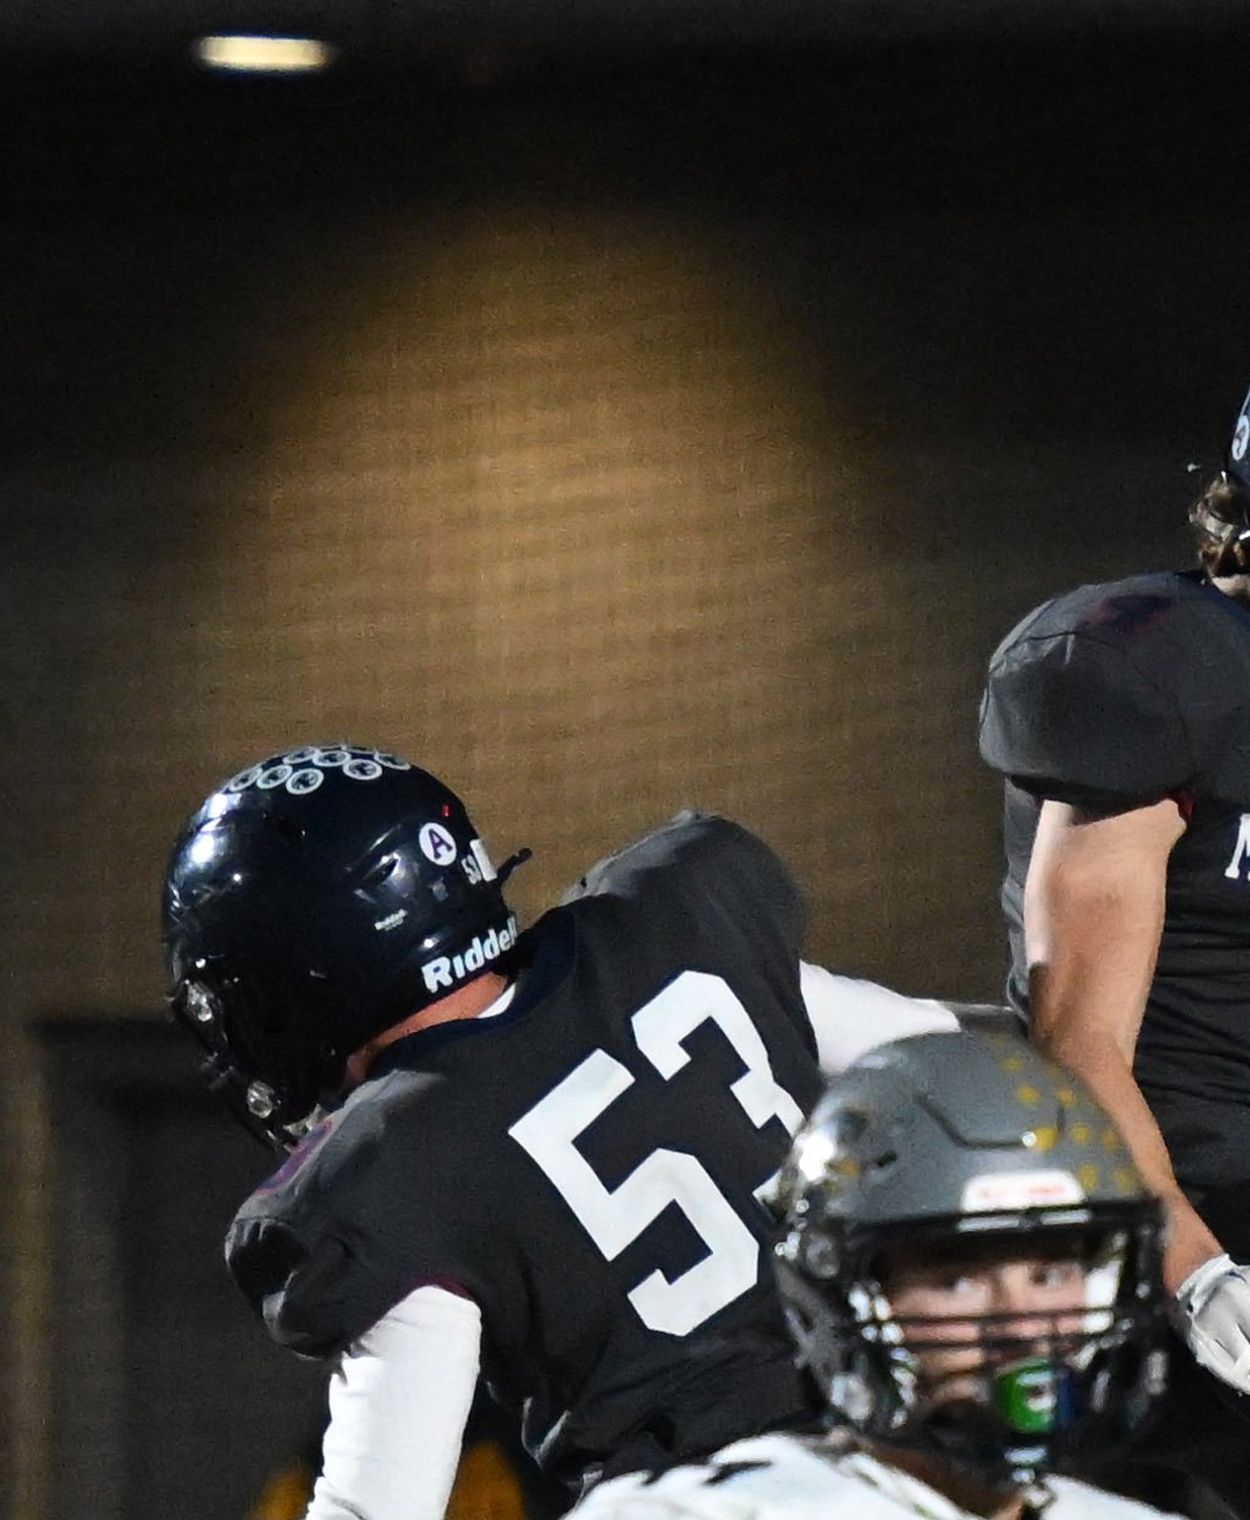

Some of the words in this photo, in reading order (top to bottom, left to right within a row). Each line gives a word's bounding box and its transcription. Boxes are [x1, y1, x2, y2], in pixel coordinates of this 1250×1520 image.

[428, 828, 453, 860] A
[421, 916, 517, 993] Riddell
[508, 970, 808, 1336] 53
